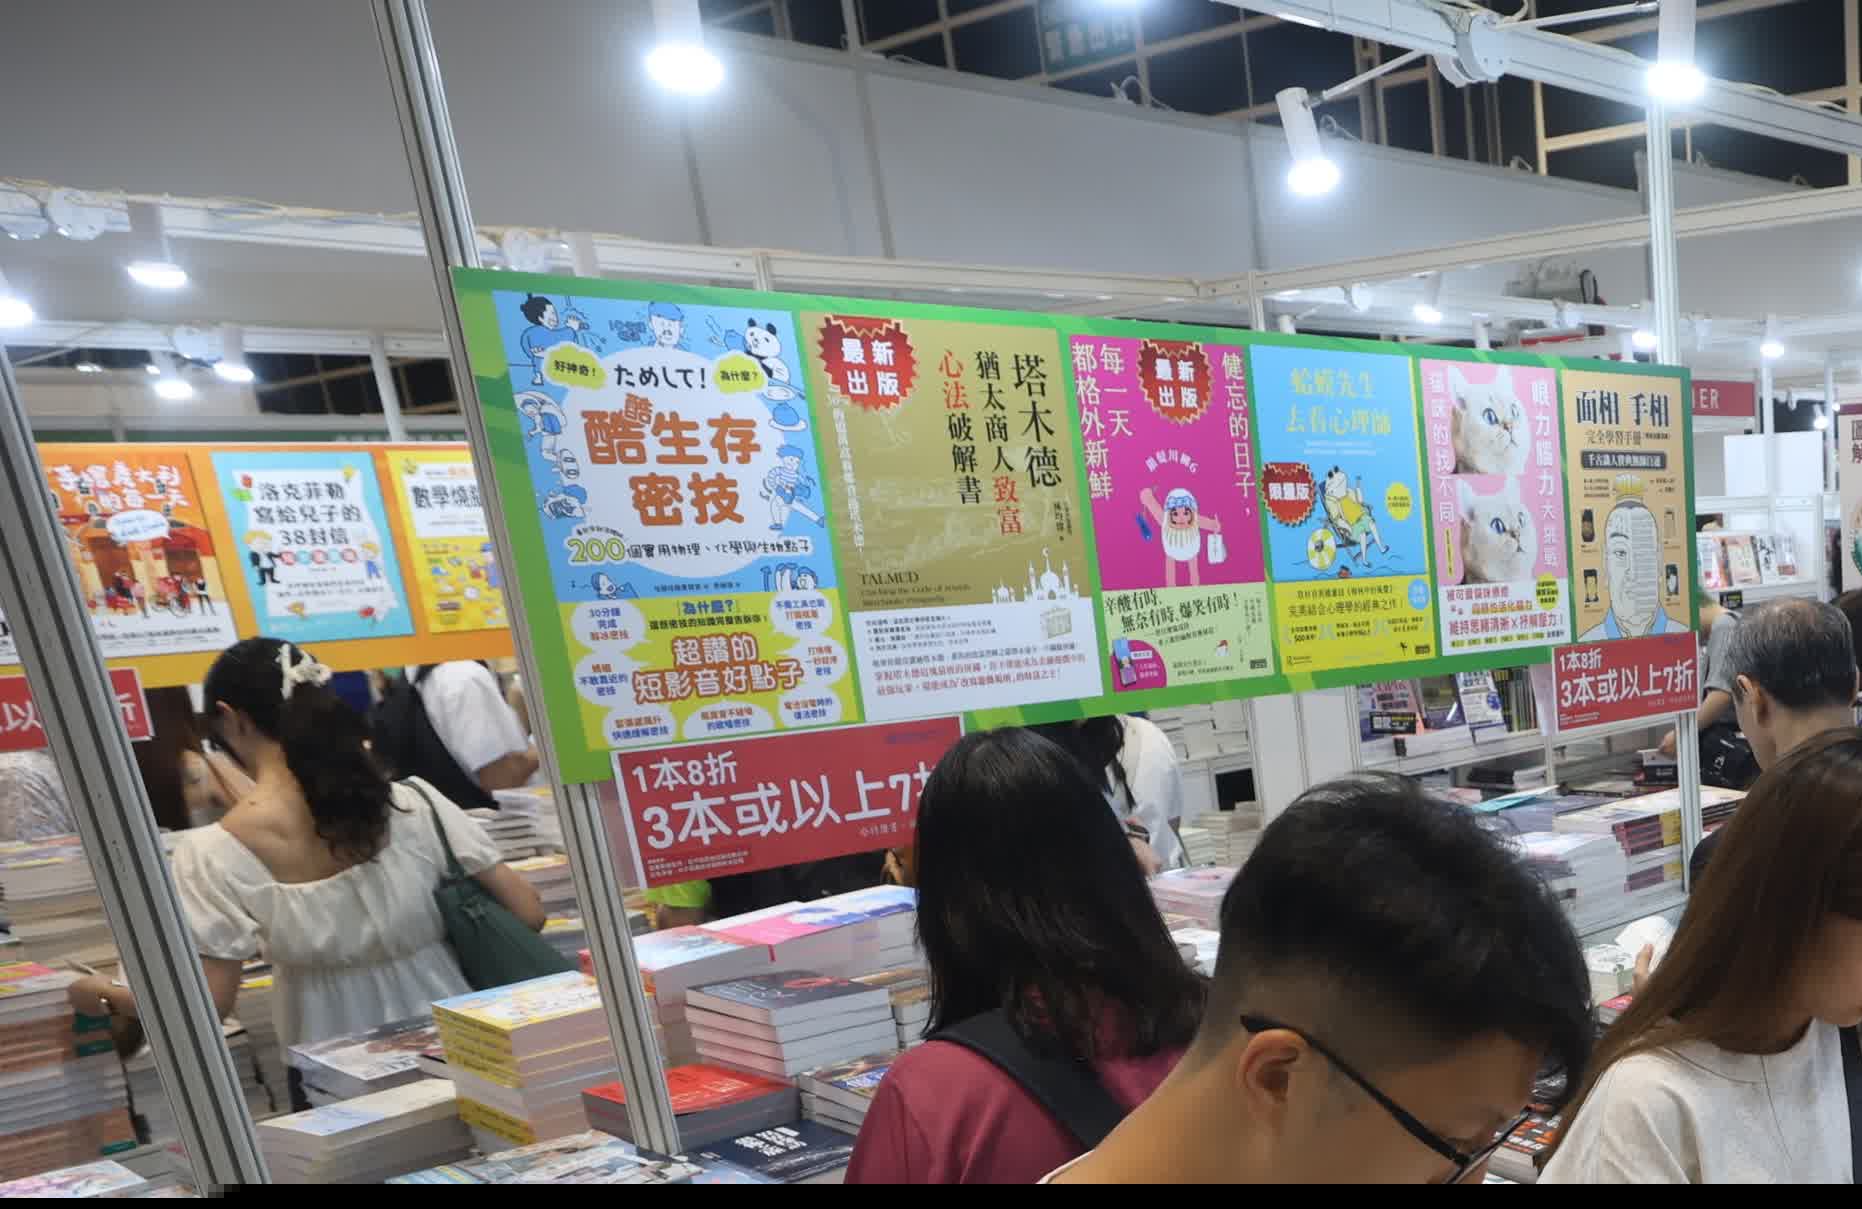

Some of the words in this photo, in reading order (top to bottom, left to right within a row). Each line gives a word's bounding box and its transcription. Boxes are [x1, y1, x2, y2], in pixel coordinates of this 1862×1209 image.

[841, 338, 895, 366] 最新
[847, 371, 900, 397] 出版
[1100, 344, 1133, 437] 每一天
[1158, 385, 1199, 409] 出版
[938, 350, 982, 505] 心法破解書
[1011, 353, 1062, 488] 塔木德
[1072, 342, 1113, 499] 都格外新鮮
[1576, 389, 1620, 425] 面相
[1630, 392, 1669, 427] 手相
[581, 410, 761, 465] 酷生存
[975, 350, 1025, 537] 猶太商人致富
[260, 482, 345, 501] 洛克菲勒
[628, 472, 745, 526] 密技
[254, 504, 362, 525] 寫給兒子的
[280, 527, 348, 545] 38封信
[858, 571, 919, 586] TALMUD
[673, 633, 757, 666] 超讚的
[1559, 648, 1602, 672] 1本8折
[634, 660, 804, 702] 短影音好點子
[1561, 658, 1695, 708] 3本或以上7折
[632, 750, 737, 793] 1本8折
